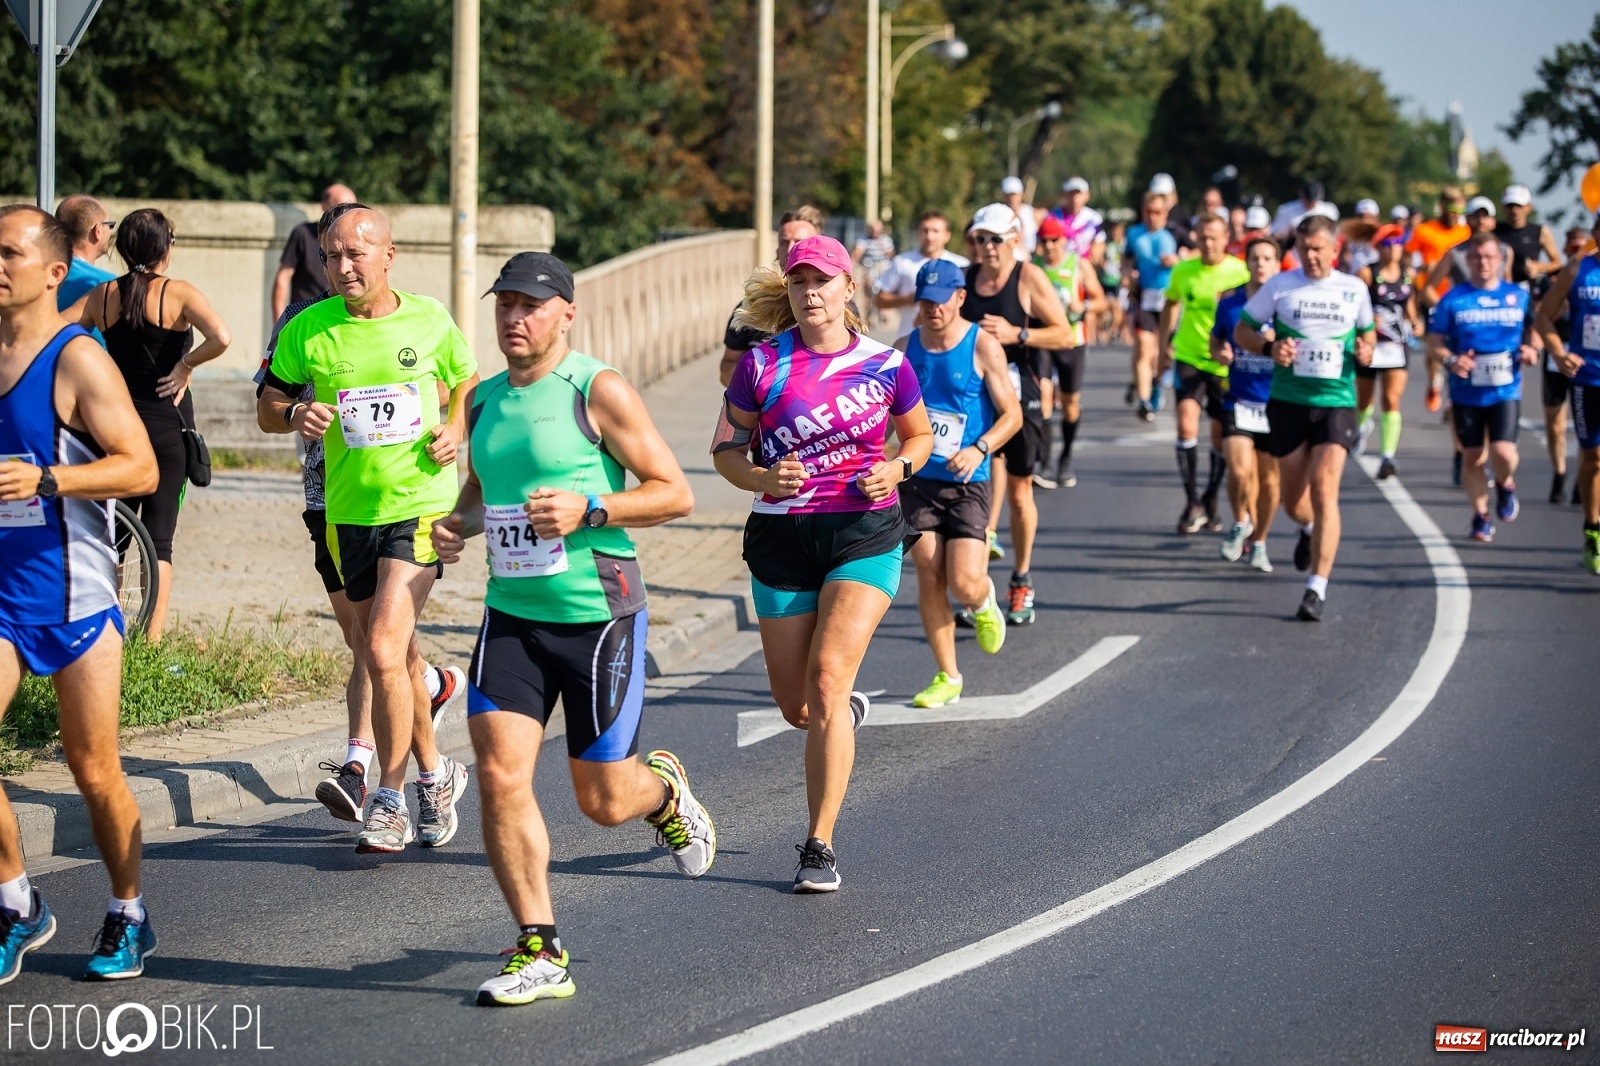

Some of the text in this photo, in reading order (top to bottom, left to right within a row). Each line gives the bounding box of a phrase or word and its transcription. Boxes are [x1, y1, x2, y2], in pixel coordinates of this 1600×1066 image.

[1578, 285, 1600, 300] RU
[370, 401, 395, 422] 79
[774, 379, 886, 451] RAFAKO
[497, 524, 539, 548] 274
